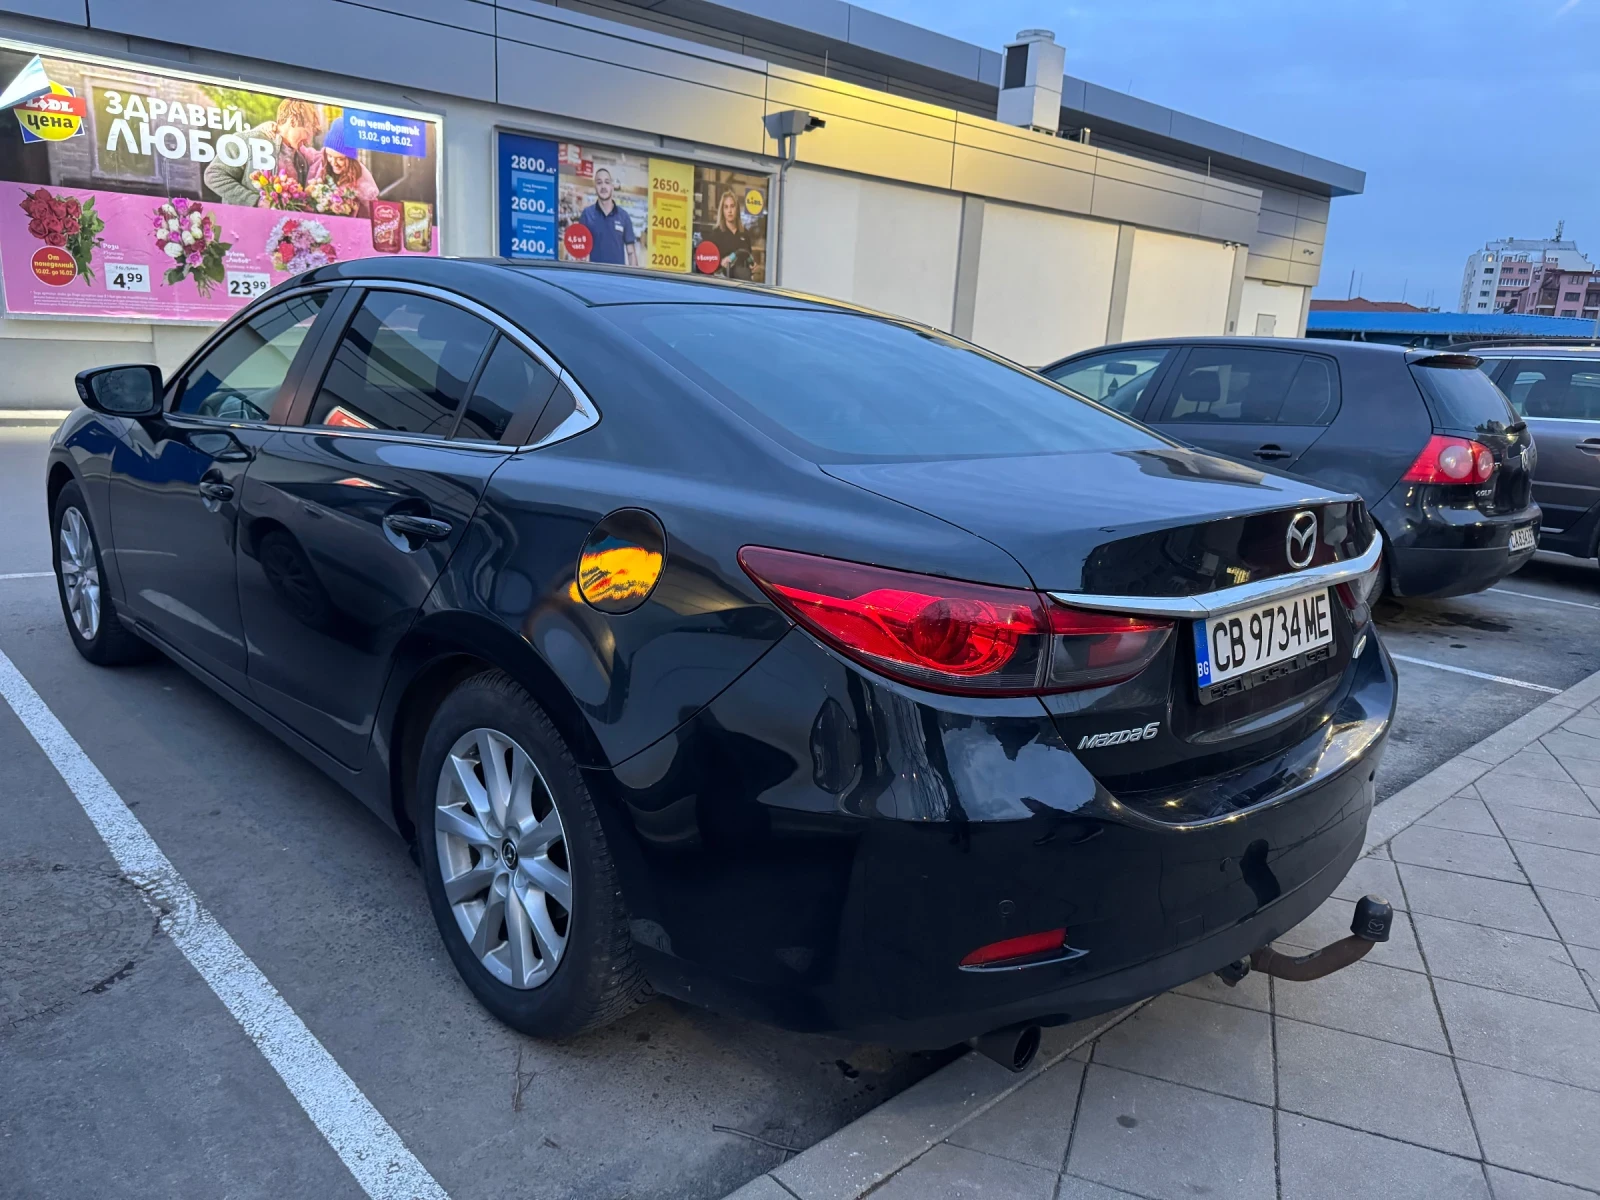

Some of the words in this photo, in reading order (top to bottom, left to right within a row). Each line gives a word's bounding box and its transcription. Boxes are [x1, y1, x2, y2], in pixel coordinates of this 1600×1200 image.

[104, 91, 251, 132] ЗДРАВЕЙ,
[27, 114, 74, 130] цена
[350, 115, 366, 127] От
[367, 121, 420, 136] четвъртък
[106, 118, 276, 171] ЛЮБОВ
[358, 130, 379, 142] 13.02.
[381, 136, 390, 145] до
[392, 136, 413, 147] 16.02.
[511, 155, 546, 172] 2800
[652, 177, 680, 193] 2650
[511, 196, 546, 213] 2600
[652, 215, 680, 231] 2400
[511, 237, 546, 254] 2400
[34, 261, 74, 269] понеделник
[47, 253, 60, 261] От
[651, 253, 679, 267] 2200
[1212, 617, 1246, 672] CB
[1250, 602, 1301, 661] 9734
[1303, 594, 1329, 643] ME
[1197, 660, 1210, 677] BG
